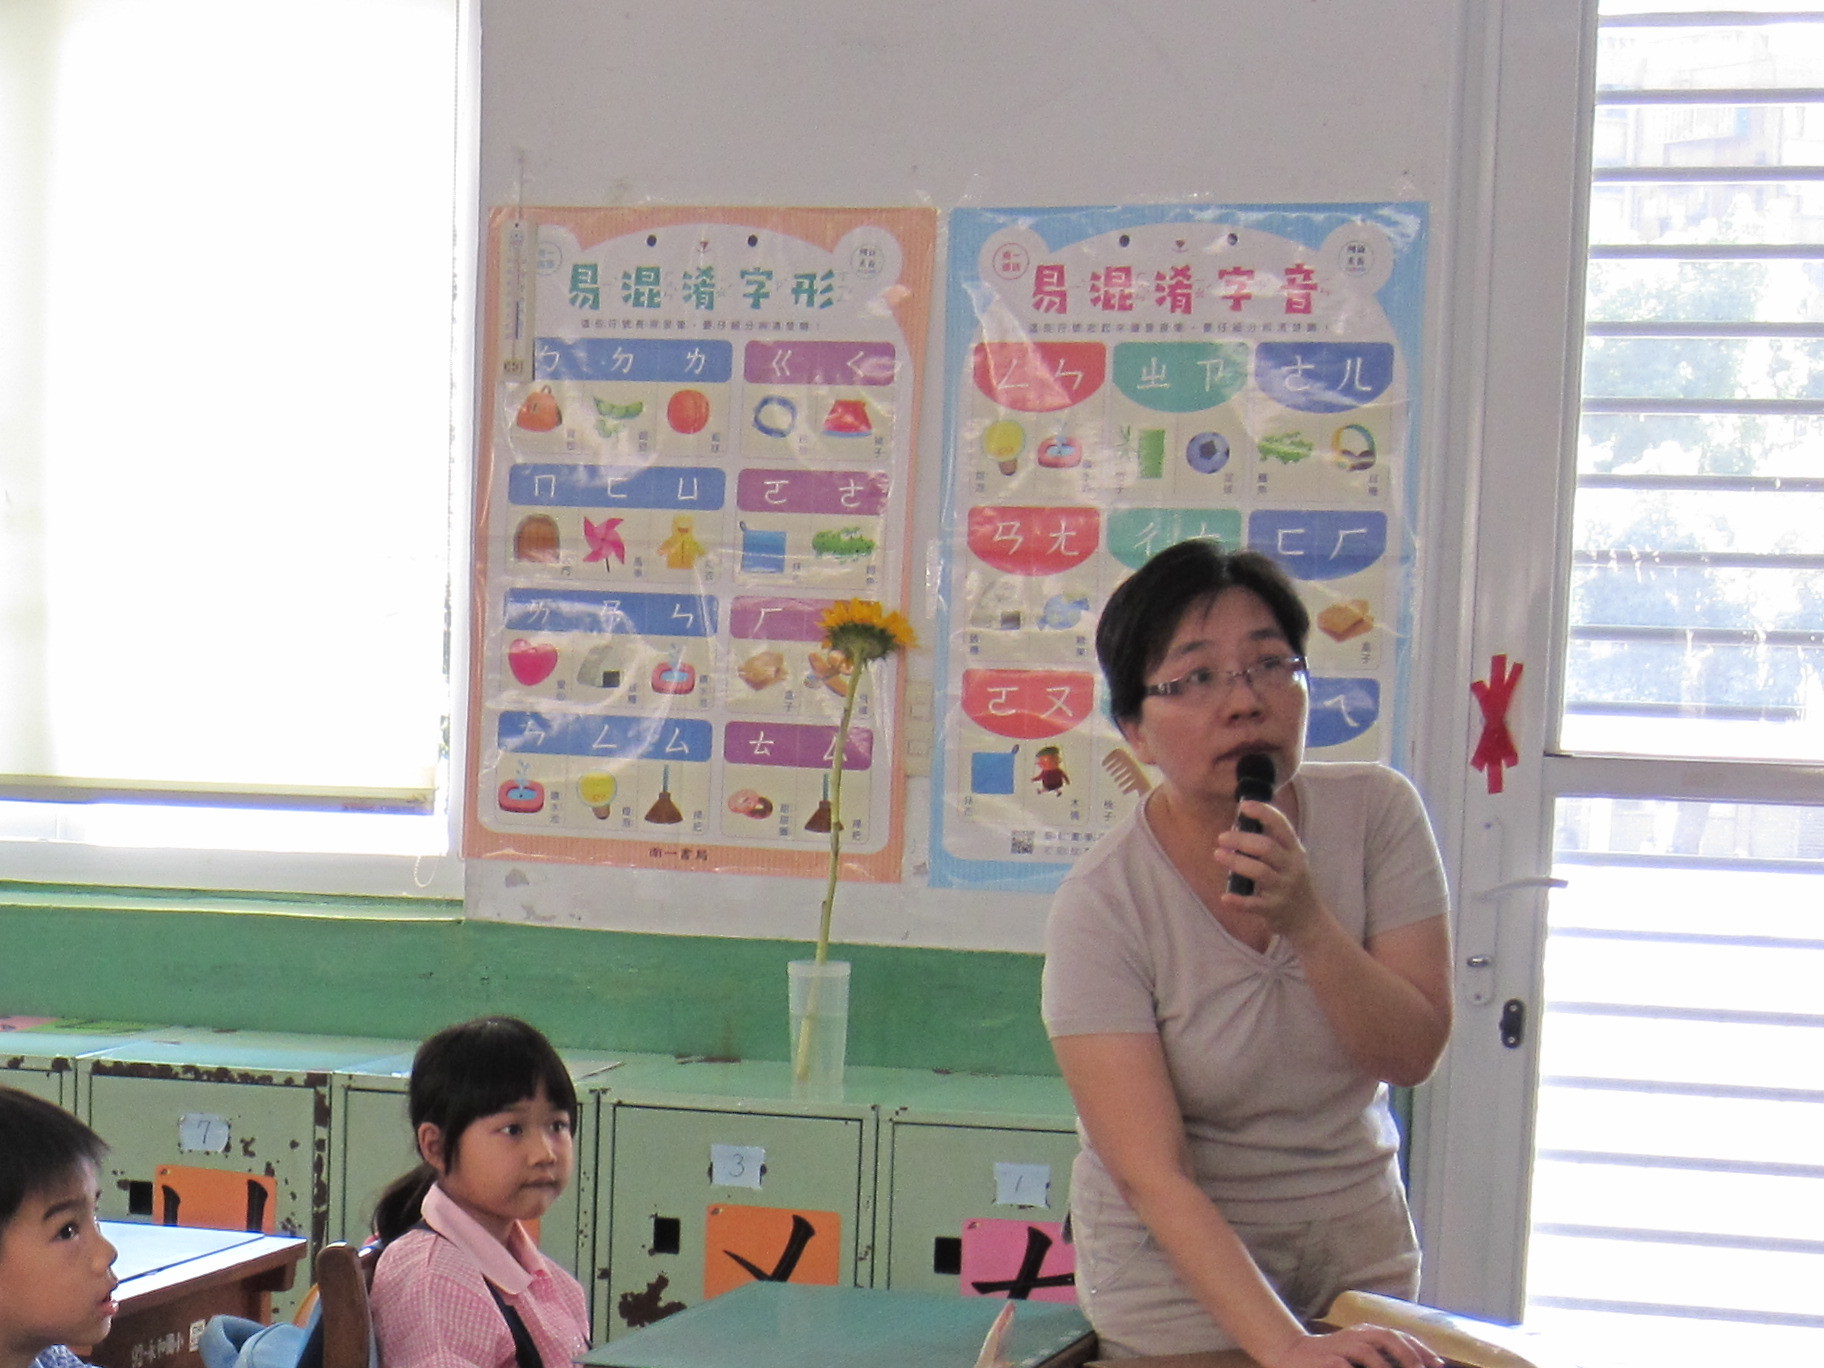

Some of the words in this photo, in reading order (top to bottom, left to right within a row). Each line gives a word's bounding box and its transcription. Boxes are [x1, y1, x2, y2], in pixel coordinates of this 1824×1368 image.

[568, 262, 836, 311] 易混淆字形
[1030, 263, 1318, 315] 易混淆字音
[611, 346, 634, 374] ㄉ
[685, 346, 706, 375] ㄌ
[771, 349, 791, 377] ㄍ
[996, 357, 1029, 391] ㄥ
[1054, 357, 1084, 390] ㄣ
[1136, 356, 1172, 391] ㄓ
[1196, 358, 1227, 393] ㄗ
[1281, 354, 1315, 393] ㄜ
[1336, 356, 1373, 392] ㄦ
[534, 473, 555, 498] ㄇ
[607, 477, 628, 498] ㄈ
[677, 477, 698, 500] ㄩ
[763, 480, 789, 505] ㄛ
[838, 478, 865, 507] ㄜ
[992, 520, 1024, 555] ㄢ
[1045, 519, 1080, 557] ㄤ
[1276, 528, 1305, 556] ㄈ
[1328, 528, 1367, 561] ㄏ
[671, 602, 694, 629] ㄣ
[753, 606, 783, 634] ㄏ
[986, 686, 1020, 717] ㄛ
[1044, 685, 1076, 718] ㄡ
[1322, 693, 1360, 728] ㄟ
[591, 724, 617, 749] ㄥ
[664, 726, 690, 754] ㄙ
[748, 730, 776, 757] ㄊ
[196, 1119, 212, 1145] 7
[730, 1152, 747, 1178] 3
